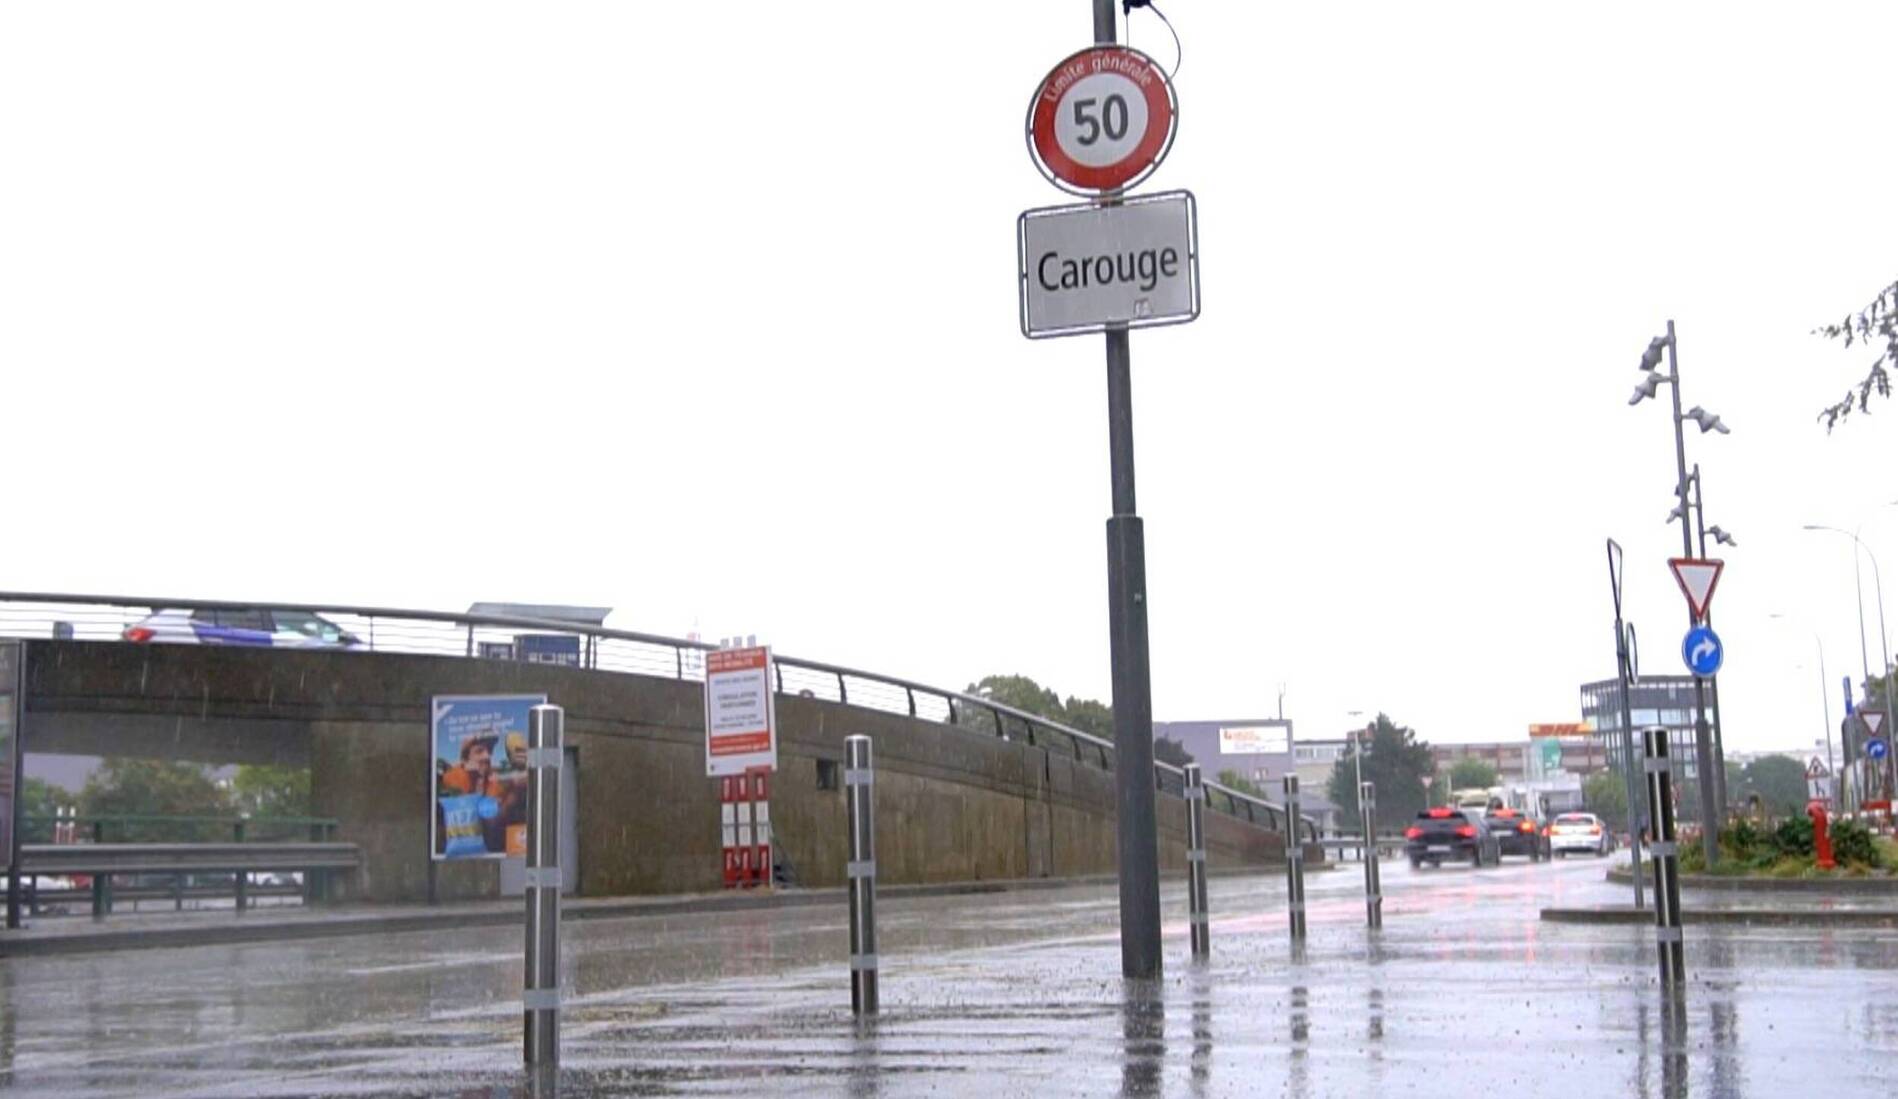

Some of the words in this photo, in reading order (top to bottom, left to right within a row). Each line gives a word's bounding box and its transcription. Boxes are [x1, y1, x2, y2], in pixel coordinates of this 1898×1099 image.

[1044, 63, 1085, 102] Limite
[1092, 55, 1152, 86] générale
[1074, 94, 1128, 146] 50
[1038, 247, 1178, 291] Carouge
